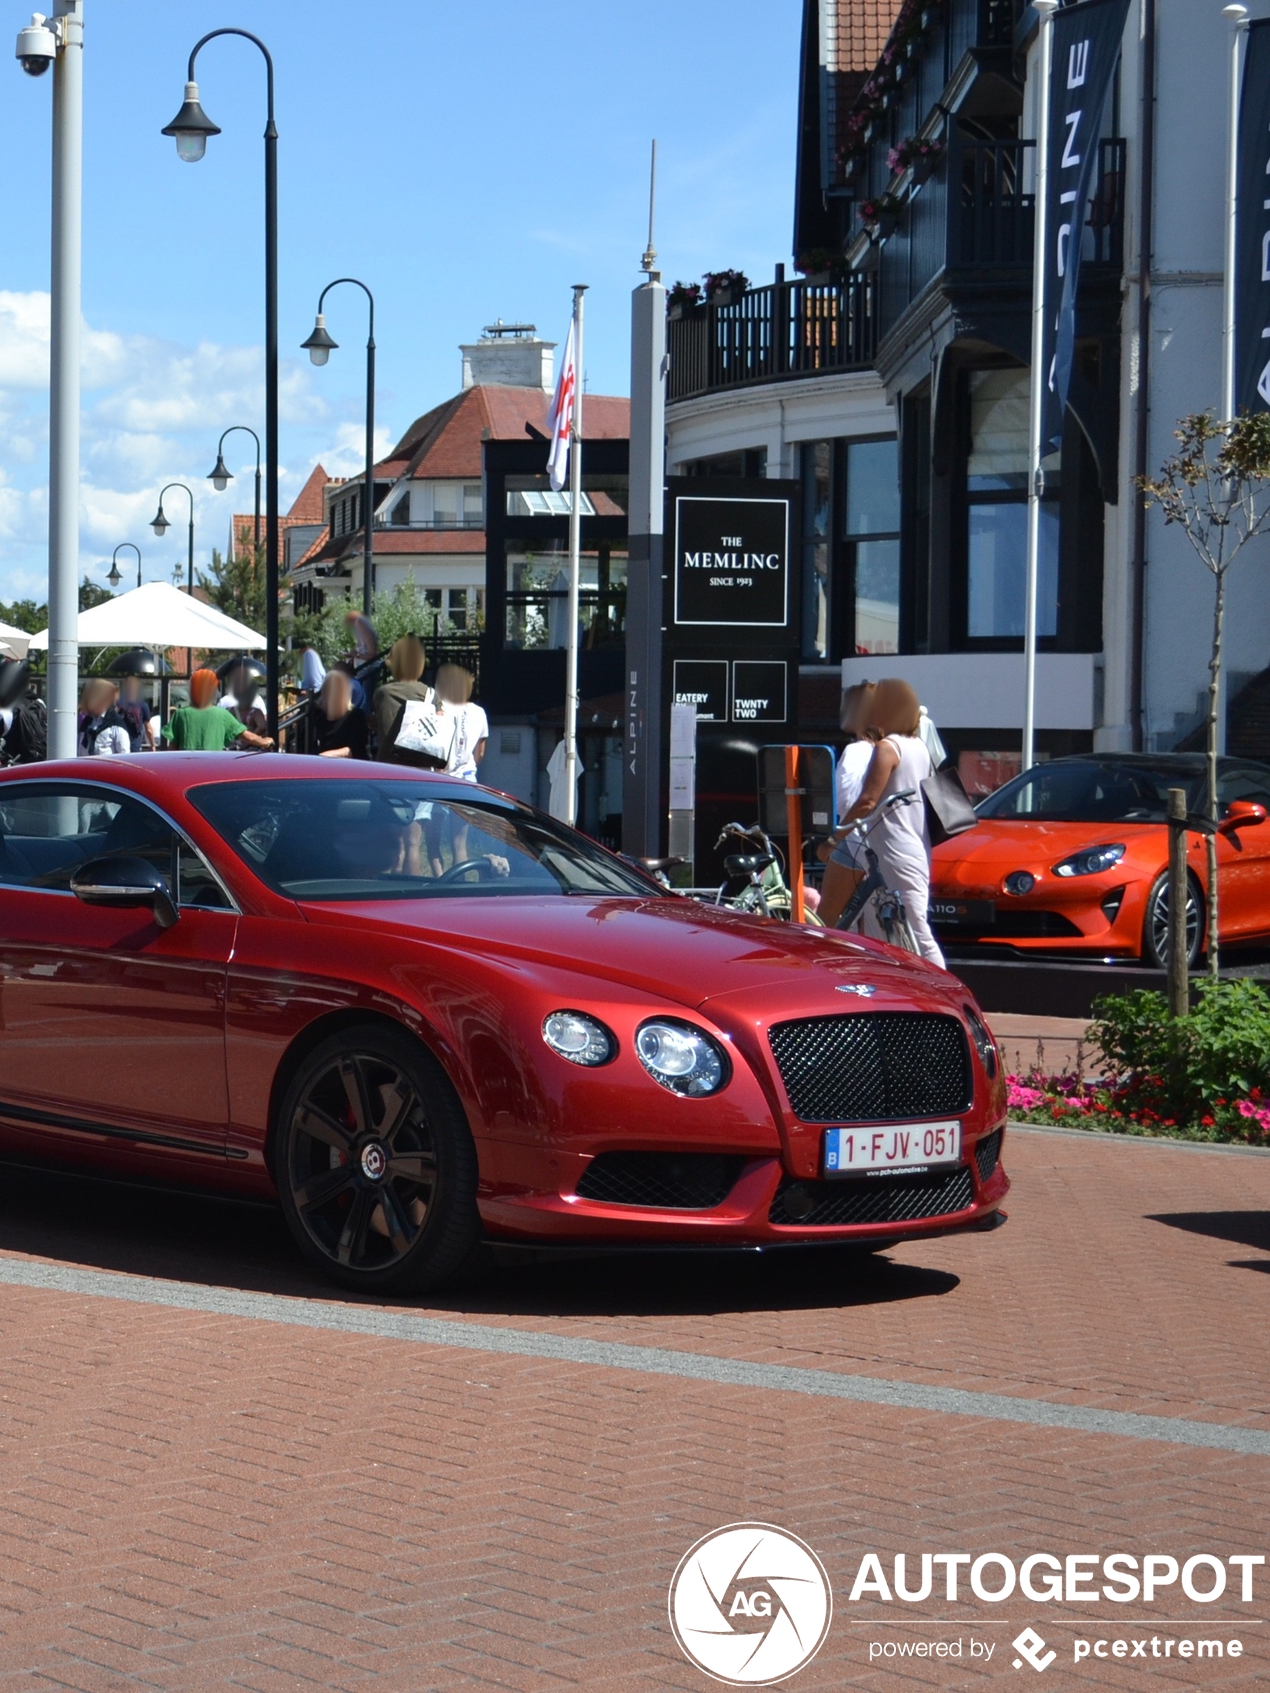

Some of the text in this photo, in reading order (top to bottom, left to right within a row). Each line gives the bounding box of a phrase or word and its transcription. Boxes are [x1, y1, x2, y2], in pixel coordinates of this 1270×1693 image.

[721, 536, 742, 547] THE
[684, 551, 779, 570] MEMLINC
[710, 577, 752, 587] SINCE 1923
[676, 693, 708, 704] EATERY
[735, 699, 768, 709] TWNTY
[735, 708, 756, 718] TWO
[845, 1128, 955, 1163] 1-FJV-051
[828, 1151, 837, 1166] B
[866, 1165, 928, 1177] www.pch-automotive.be
